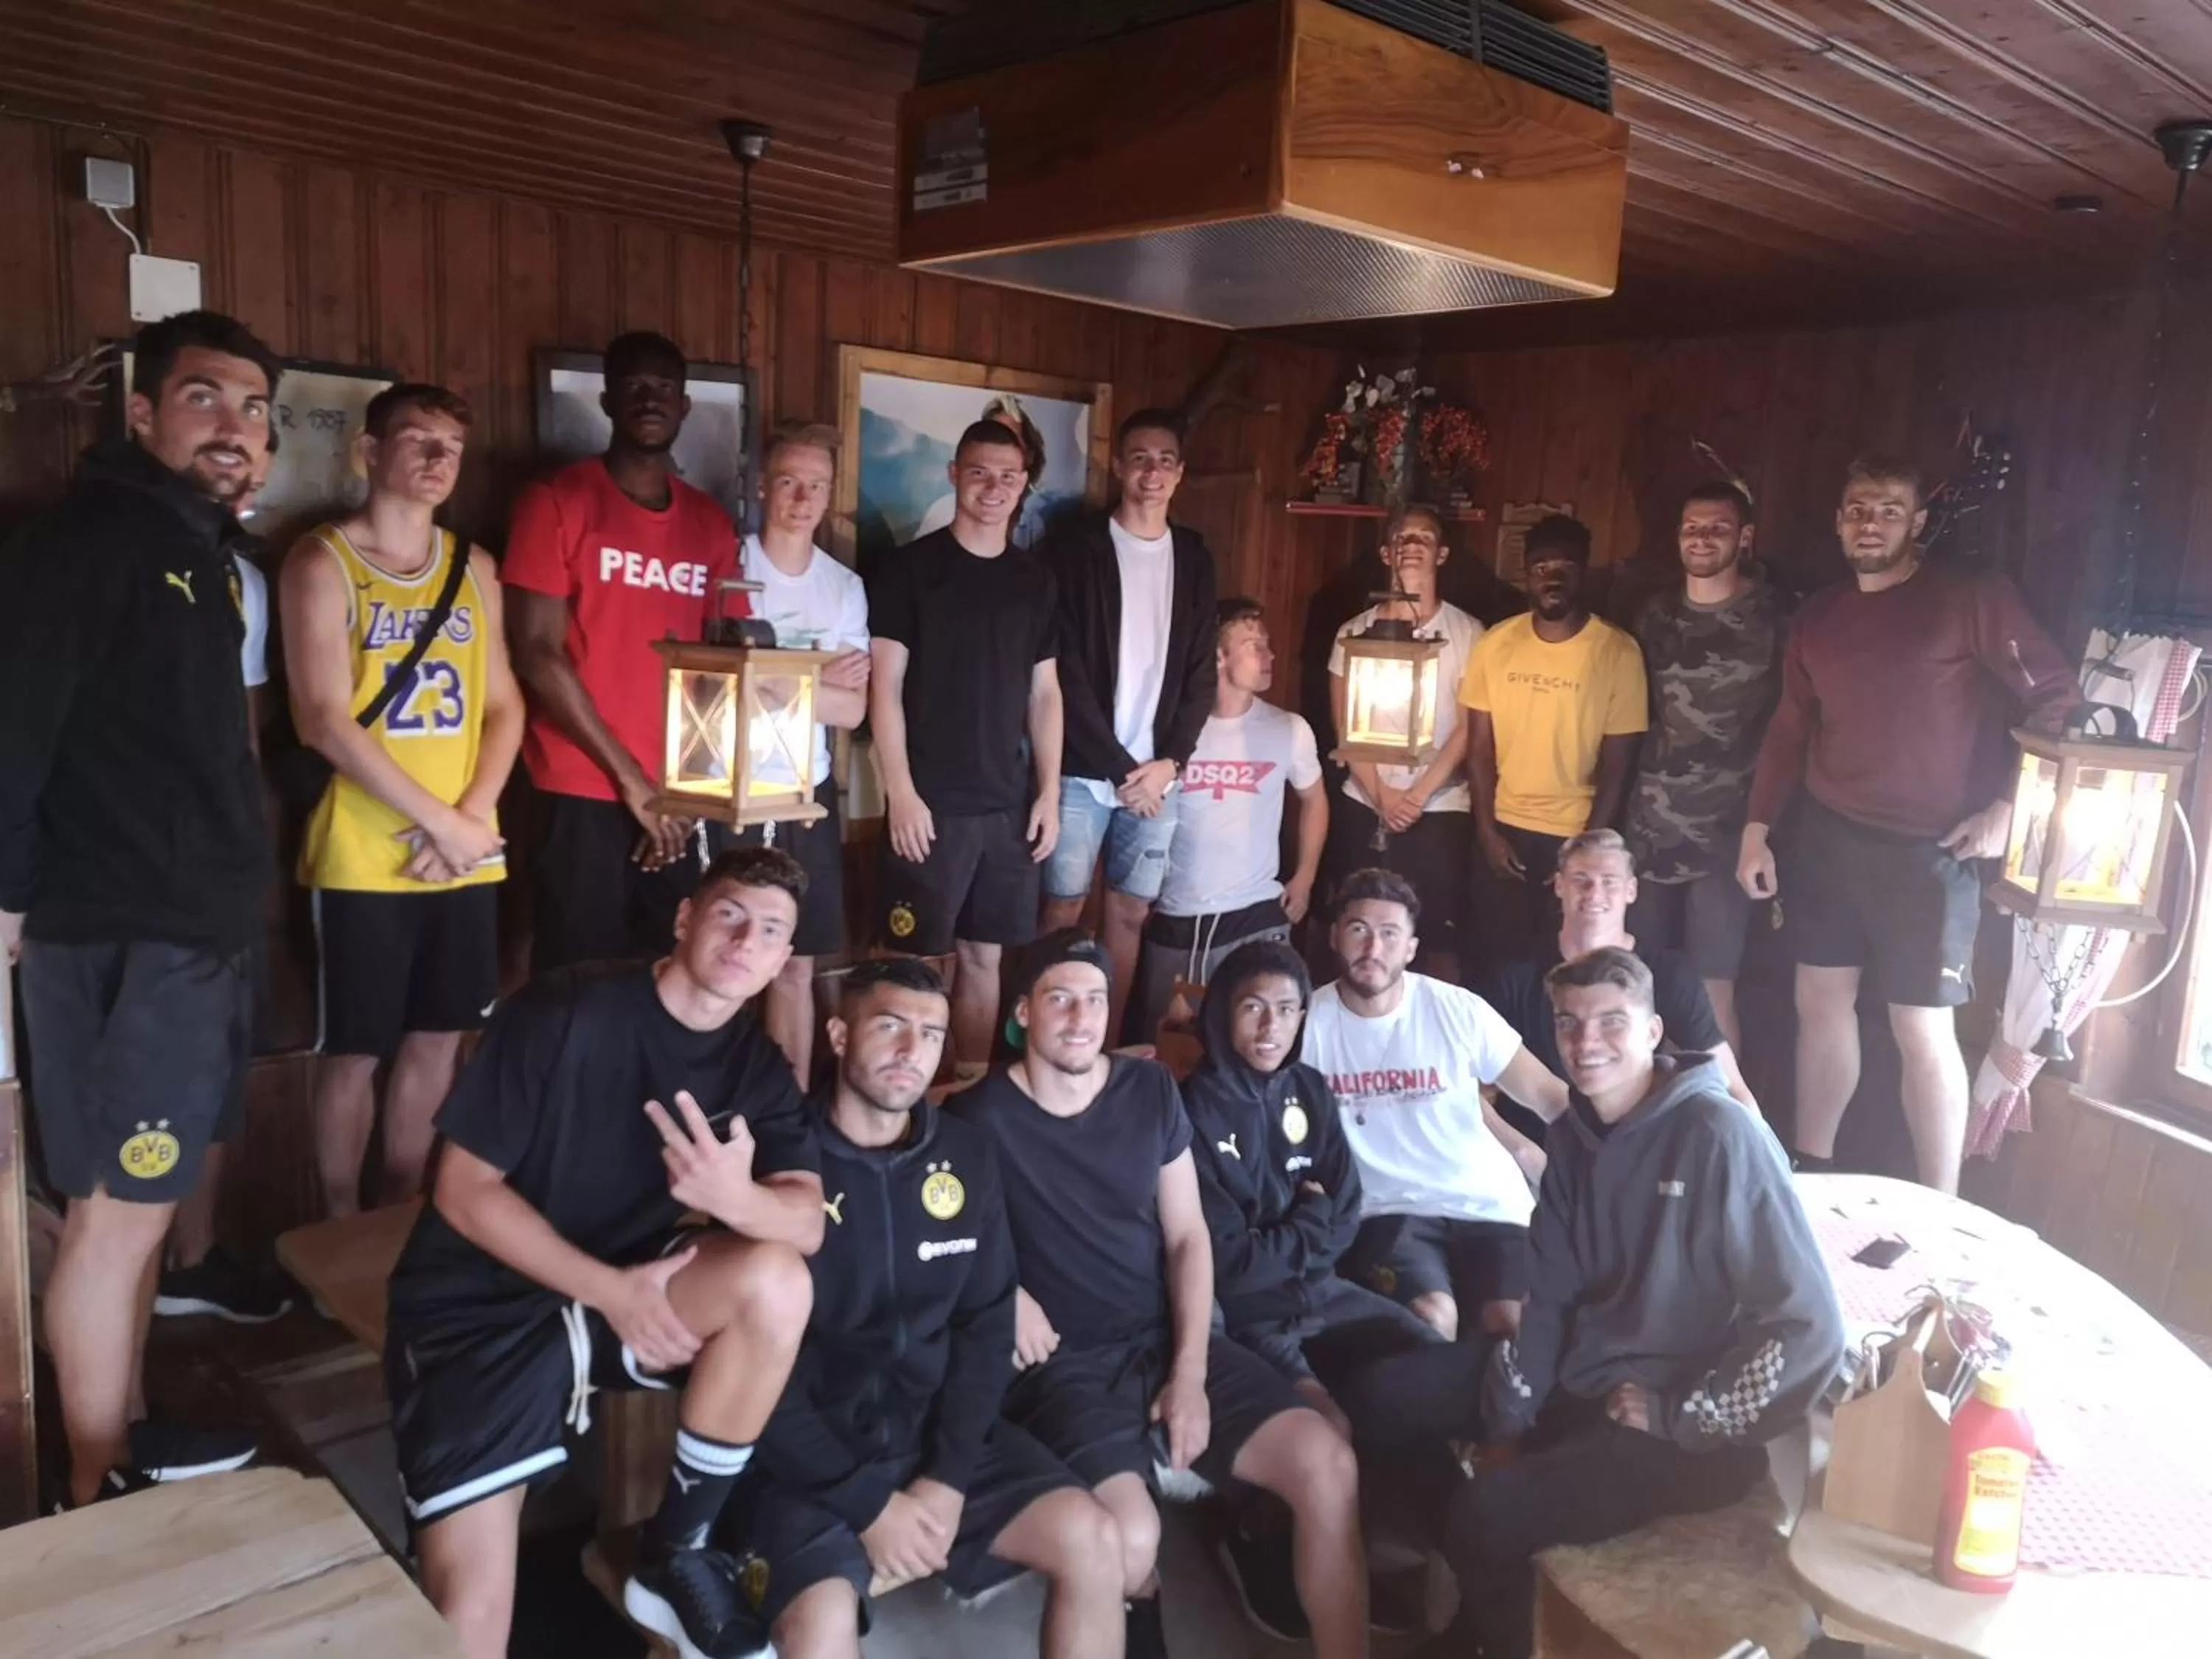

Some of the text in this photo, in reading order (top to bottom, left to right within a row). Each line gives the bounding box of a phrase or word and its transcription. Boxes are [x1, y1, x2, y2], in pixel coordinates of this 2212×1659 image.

[599, 546, 709, 597] PEACE
[383, 660, 464, 731] 23
[1186, 764, 1255, 786] DSQ2
[1325, 1066, 1440, 1096] ALIFORNIA
[130, 1135, 171, 1164] BVB
[930, 1178, 959, 1204] BVB
